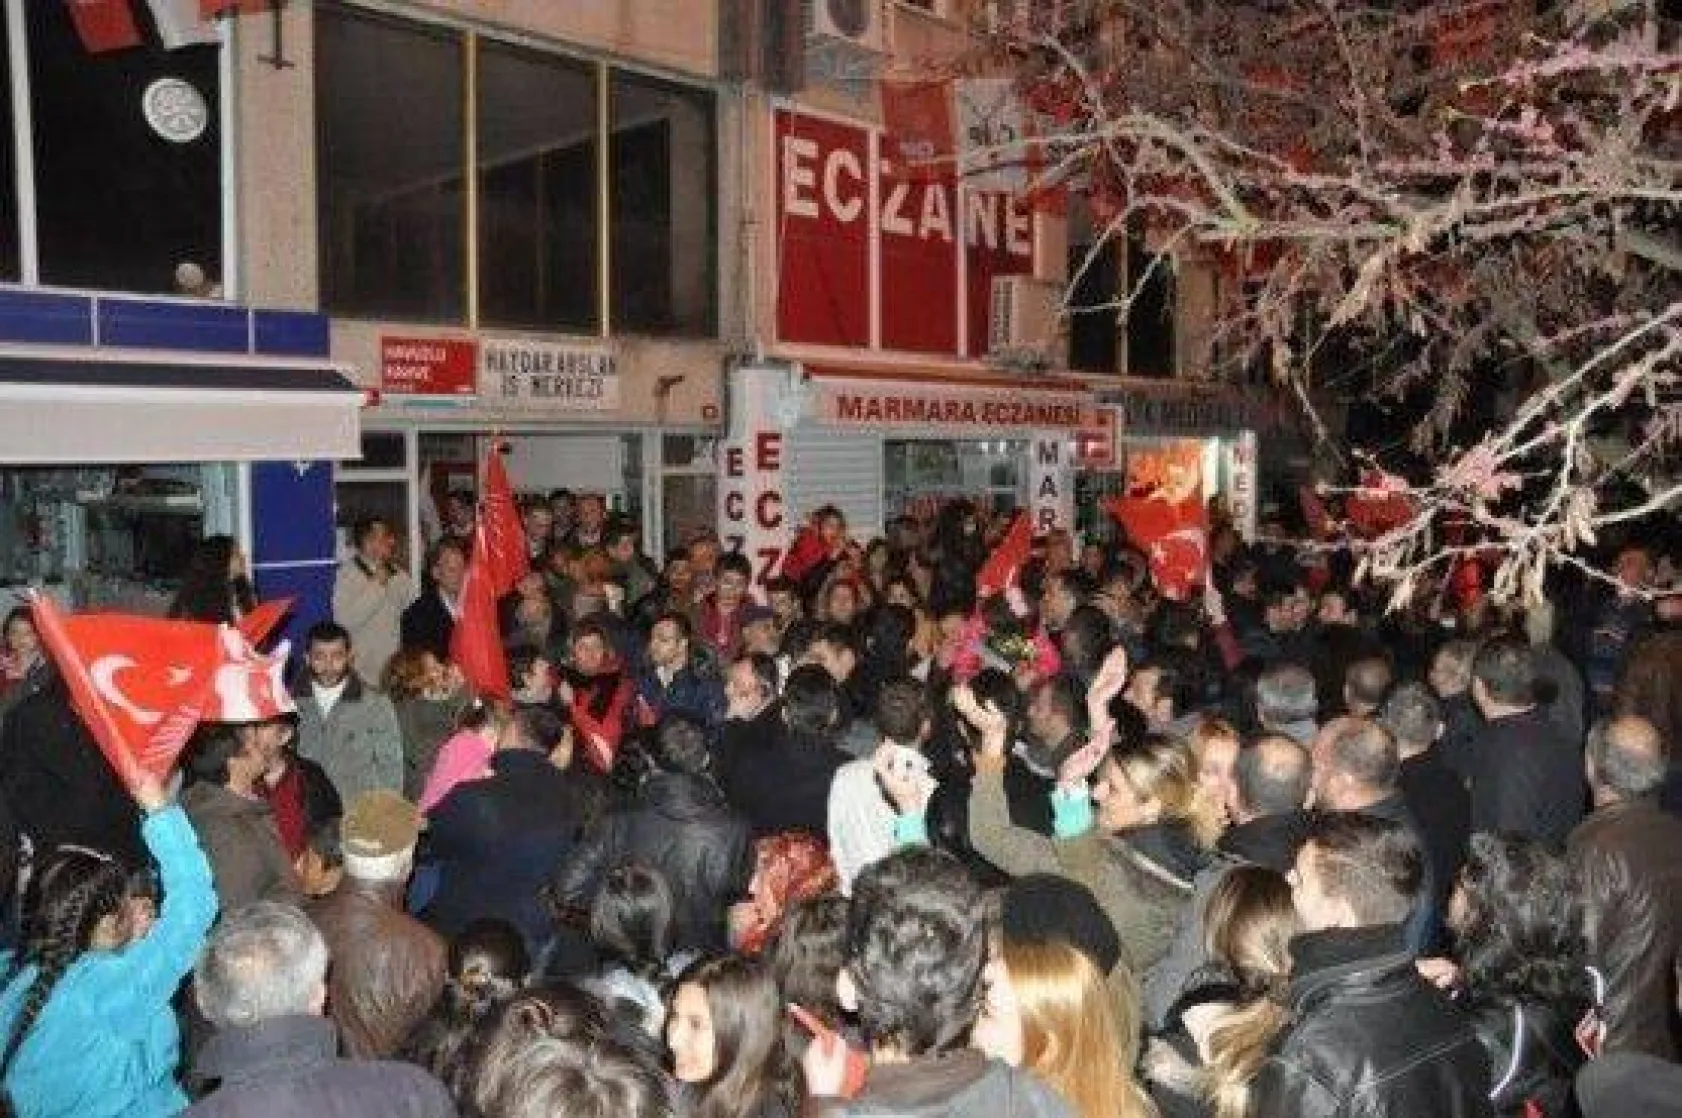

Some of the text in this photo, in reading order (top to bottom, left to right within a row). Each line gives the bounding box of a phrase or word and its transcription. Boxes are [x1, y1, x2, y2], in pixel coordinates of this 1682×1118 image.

[784, 135, 1031, 254] ECZANE
[836, 396, 976, 423] MARMARA
[1039, 439, 1058, 530] MAR
